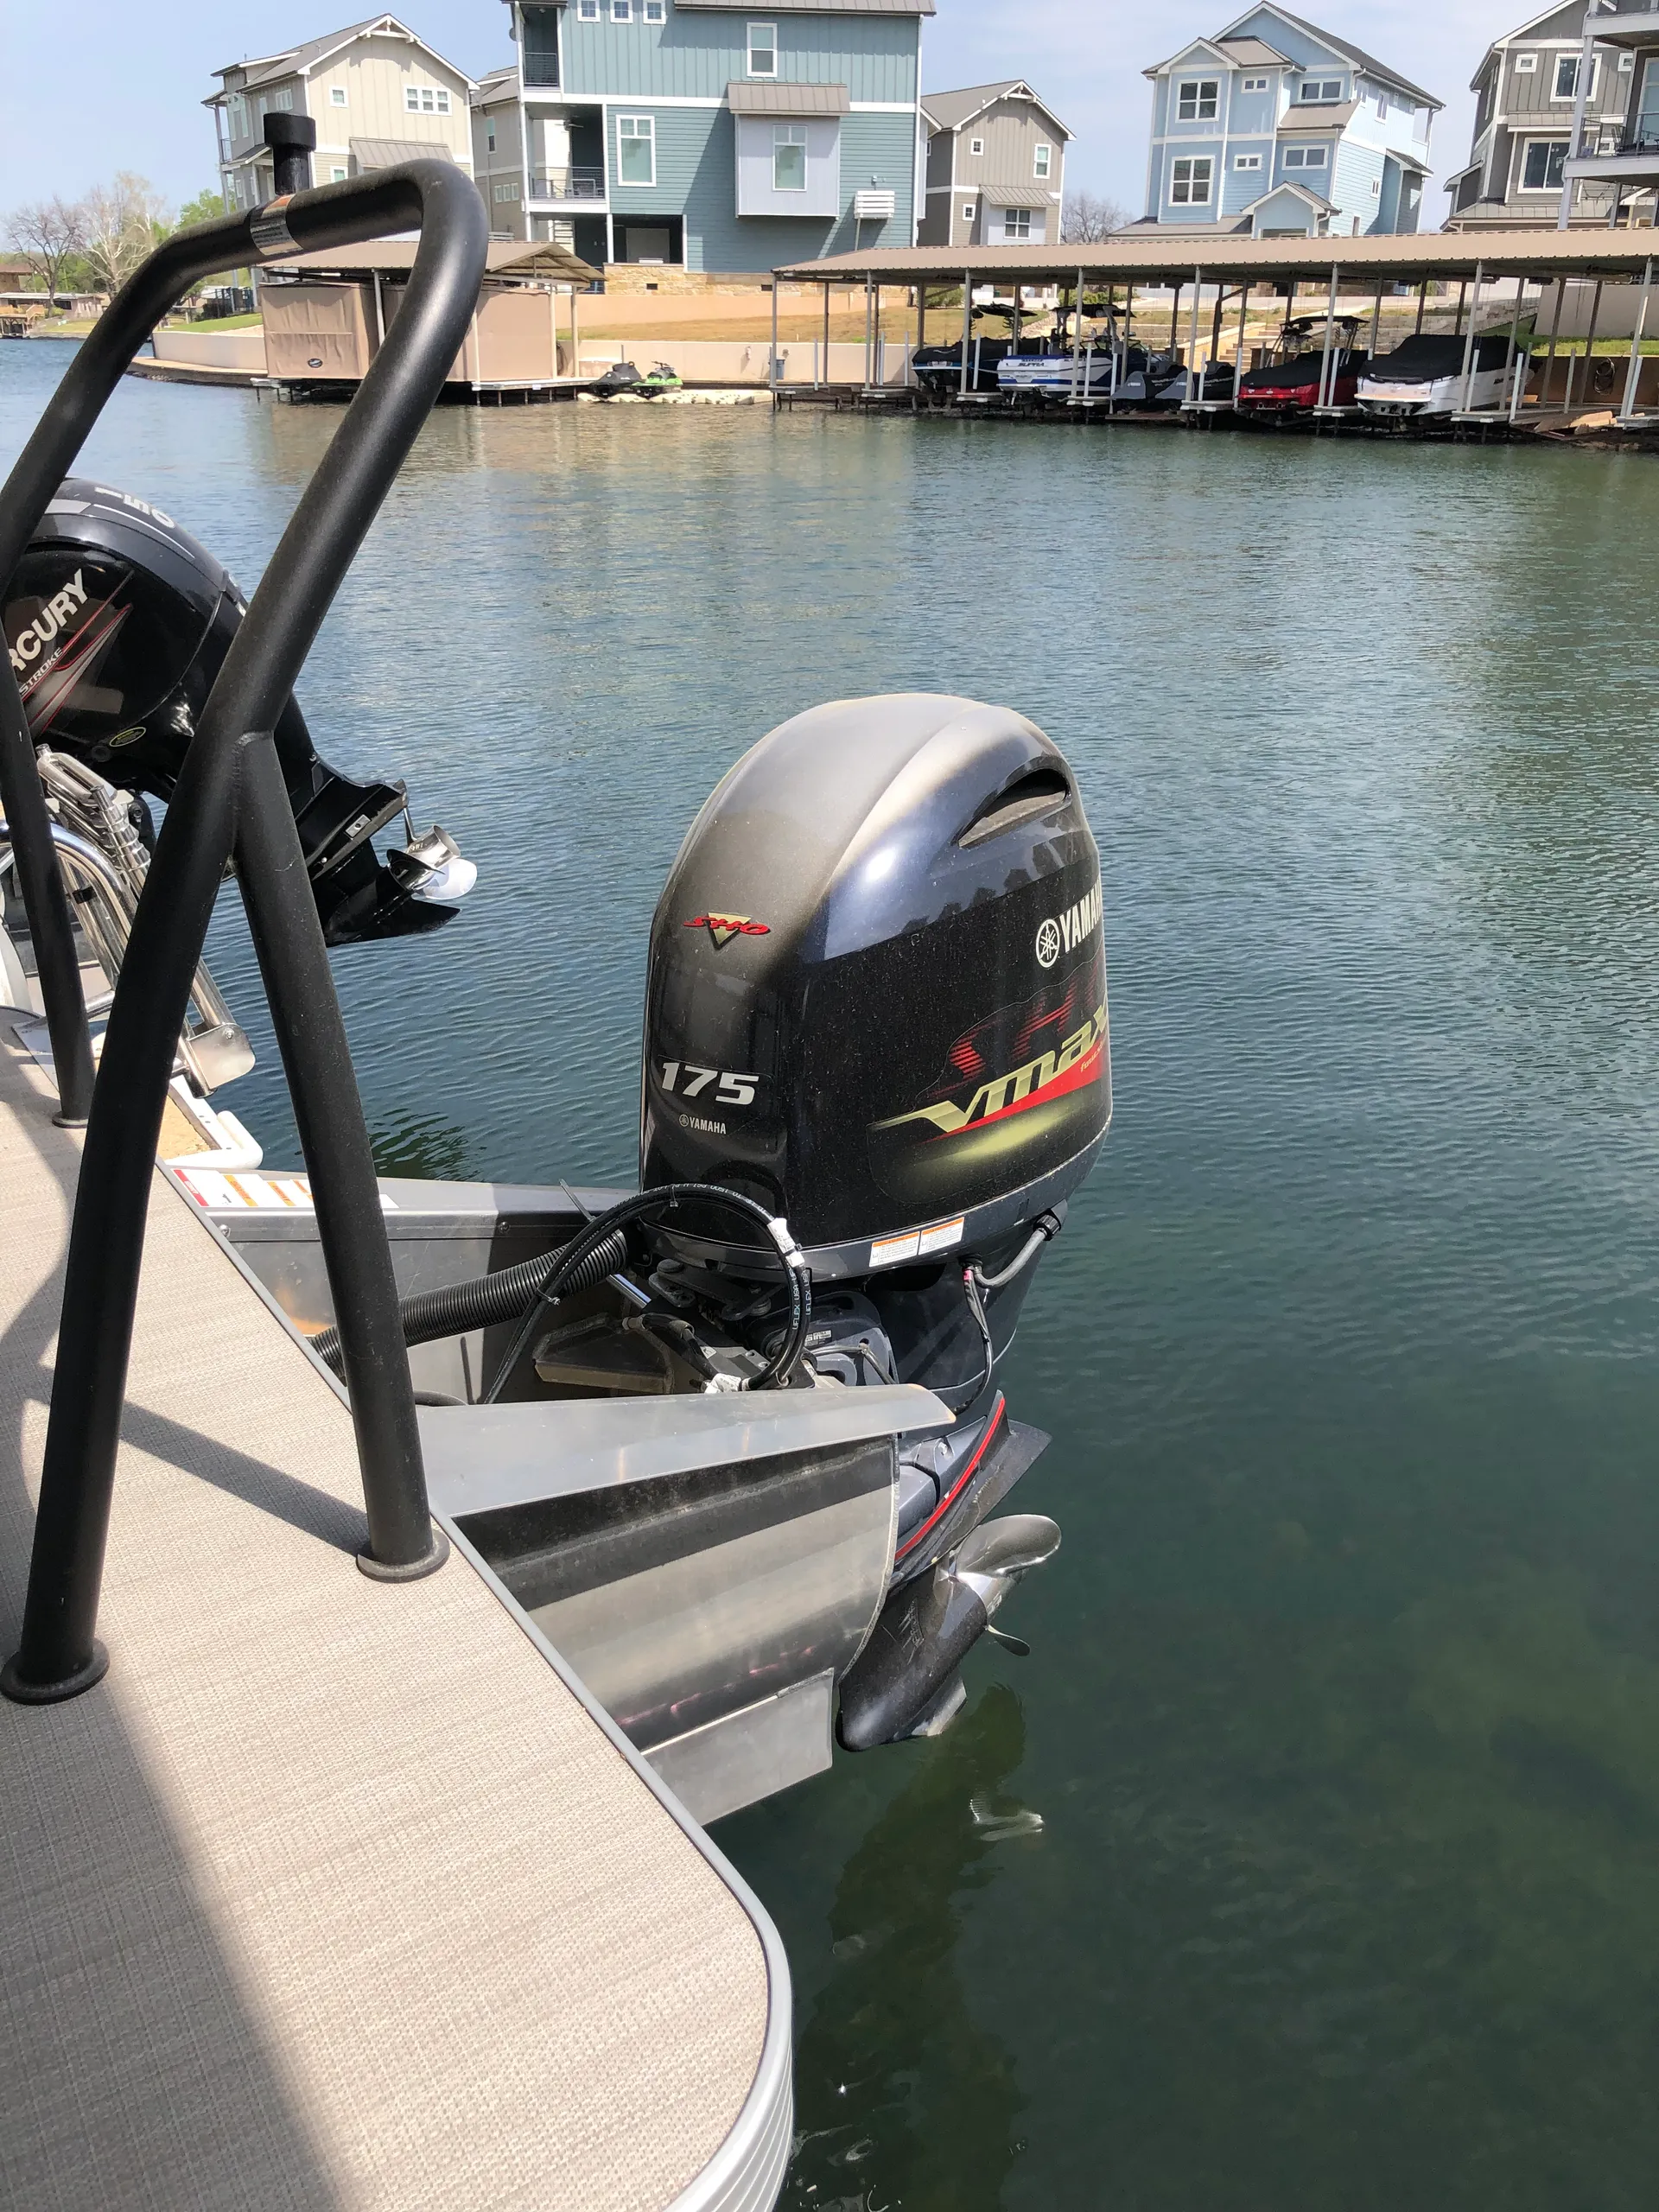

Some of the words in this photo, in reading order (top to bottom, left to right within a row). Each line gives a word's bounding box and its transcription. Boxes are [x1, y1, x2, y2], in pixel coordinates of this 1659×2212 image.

[683, 916, 772, 936] SHO
[661, 1062, 760, 1105] 175
[690, 1116, 727, 1135] YAMAHA
[801, 1270, 810, 1287] USA
[791, 1304, 801, 1330] UFLEX
